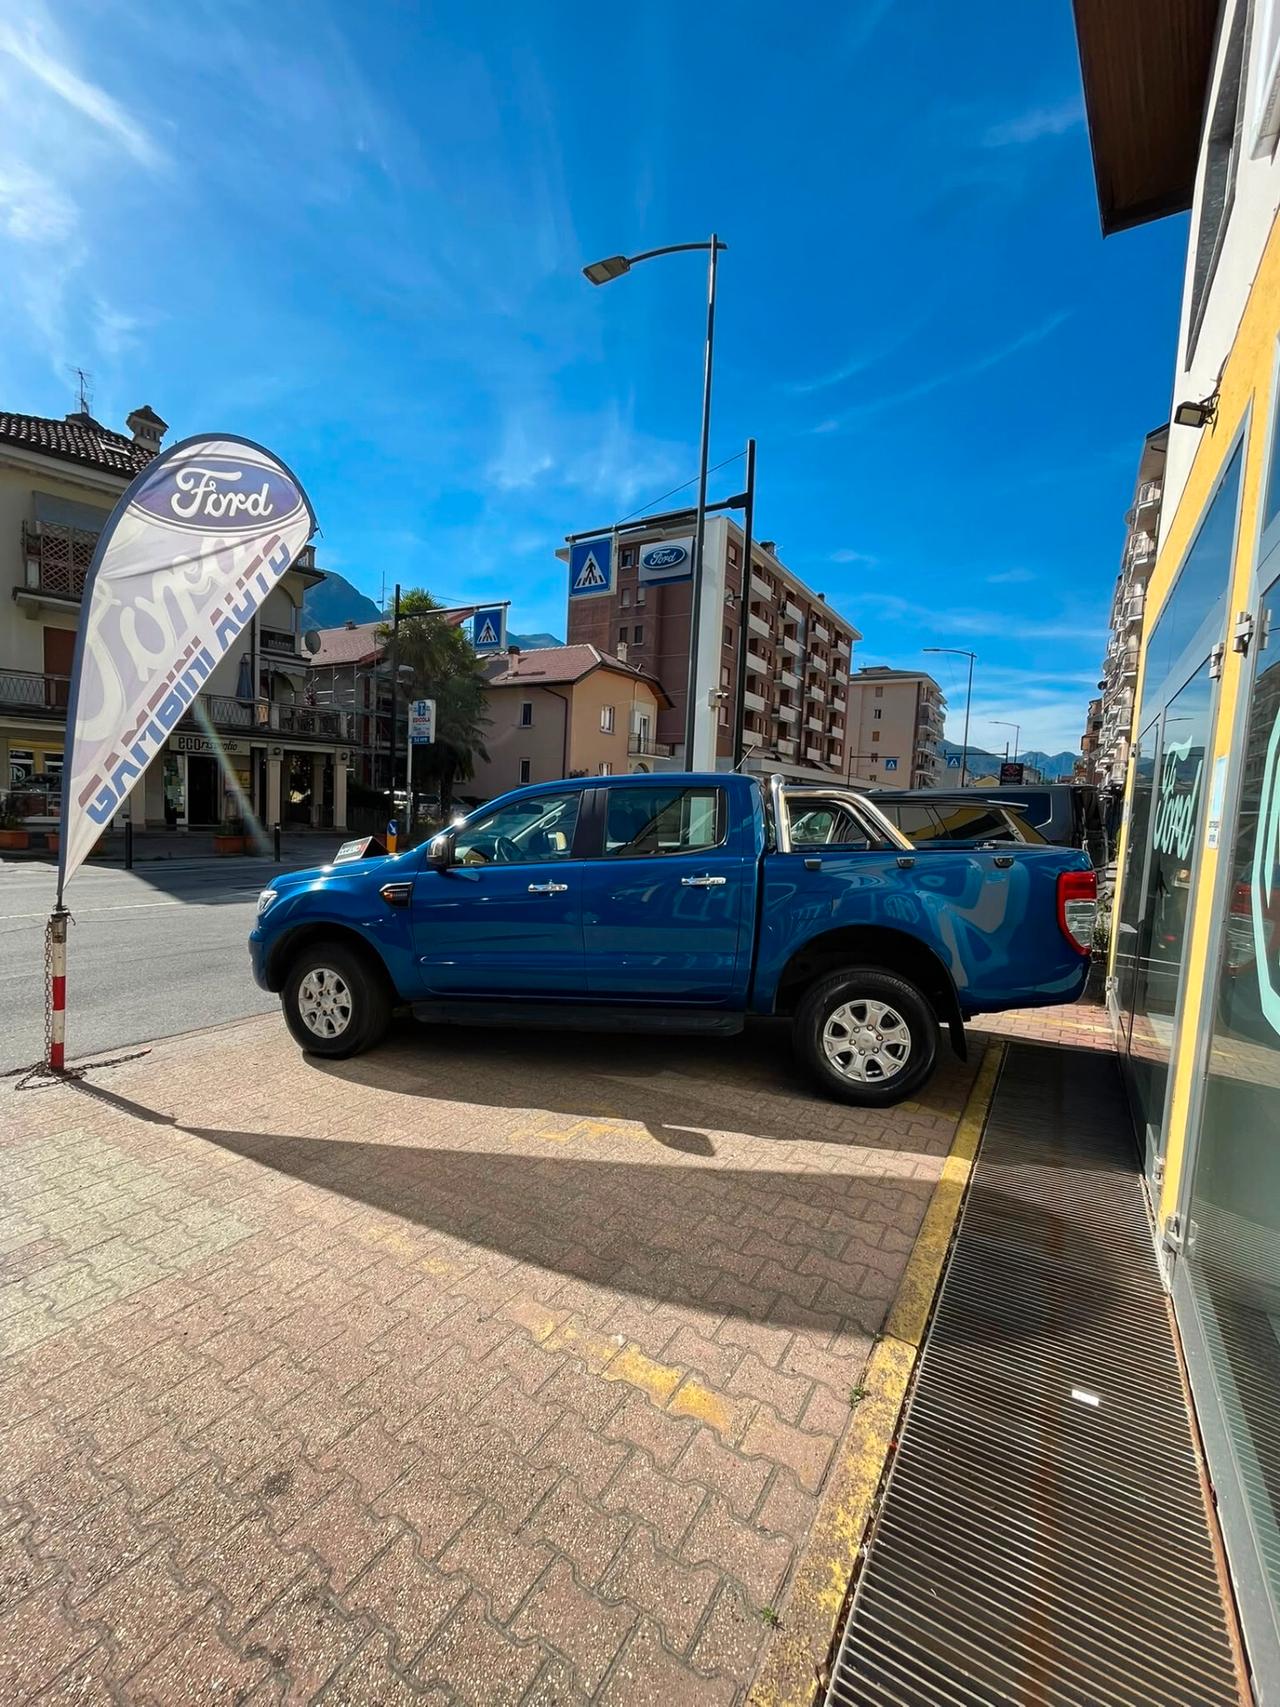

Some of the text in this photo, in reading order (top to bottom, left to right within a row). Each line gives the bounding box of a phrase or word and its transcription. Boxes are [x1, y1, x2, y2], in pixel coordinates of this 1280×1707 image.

[171, 467, 273, 518] Ford
[650, 549, 677, 565] Ford
[78, 534, 291, 825] GAMBINI AUTO
[1153, 735, 1202, 861] Ford
